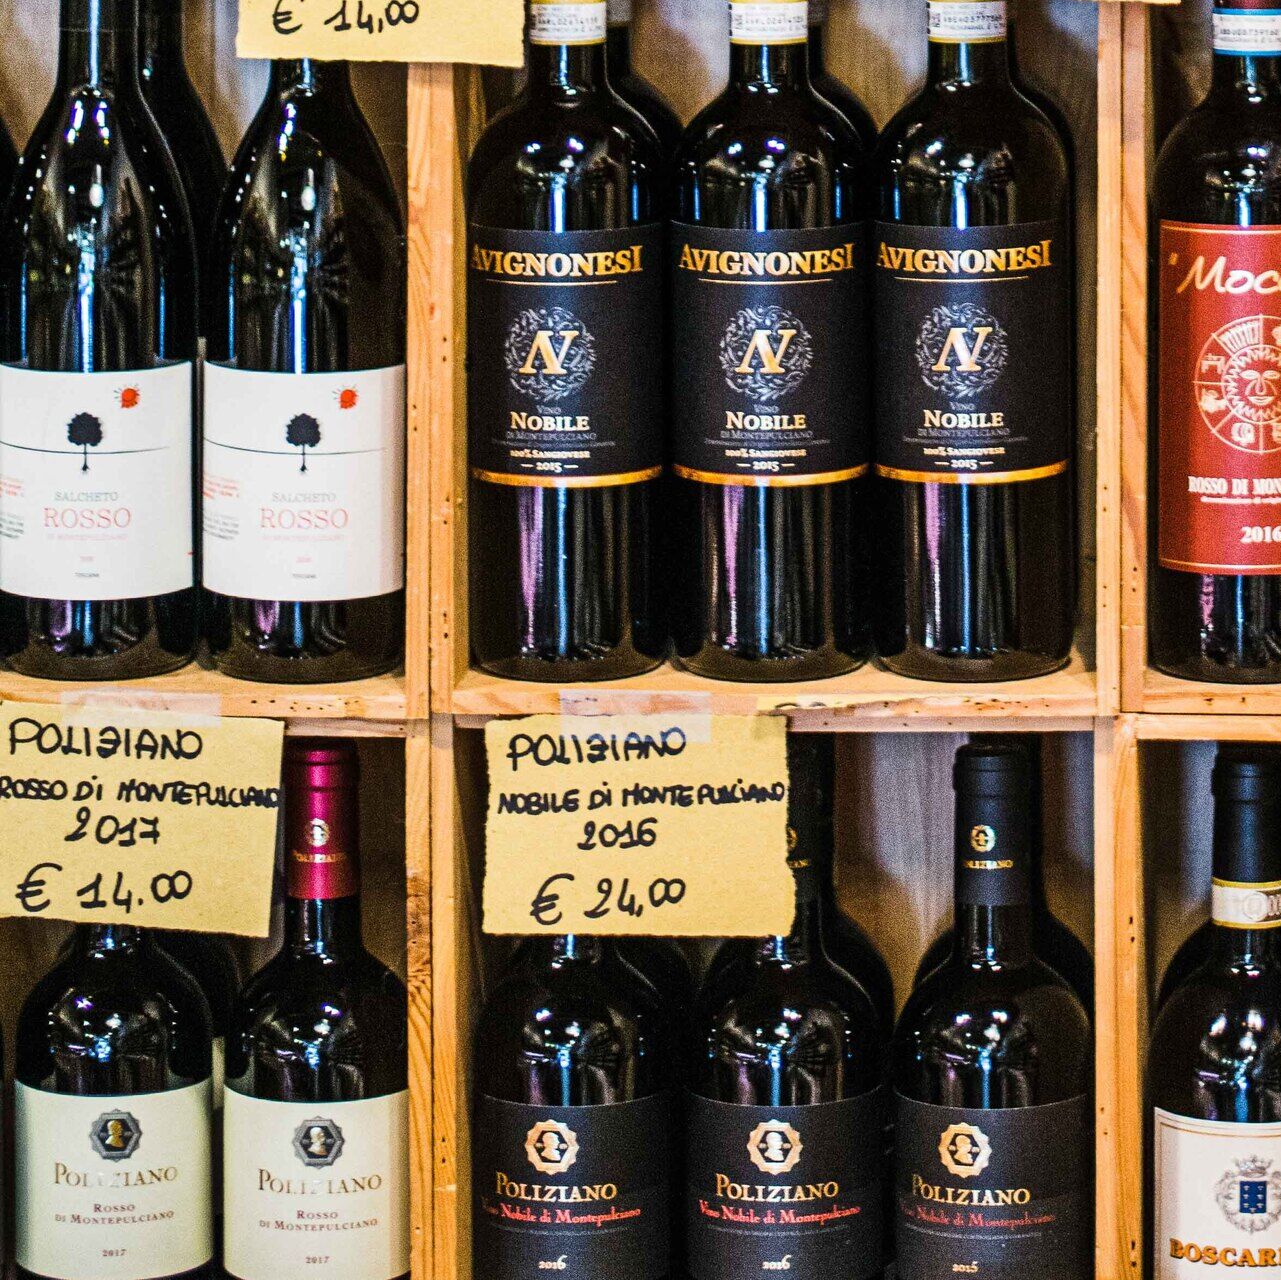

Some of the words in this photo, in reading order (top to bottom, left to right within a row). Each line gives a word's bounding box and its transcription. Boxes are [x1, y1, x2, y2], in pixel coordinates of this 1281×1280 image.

[324, 0, 420, 34] 14,00
[678, 242, 854, 276] AVIGNONESI
[725, 410, 806, 430] NOBILE
[752, 459, 780, 473] 2015
[53, 490, 119, 502] SALCHETO
[1188, 476, 1227, 494] ROSSO
[1230, 476, 1248, 492] DI
[43, 507, 133, 531] ROSSO
[64, 806, 161, 847] 2017
[577, 816, 659, 851] 2016
[15, 862, 63, 913] €
[529, 872, 575, 926] €
[496, 1172, 617, 1202] POLIZIANO
[93, 1203, 136, 1214] ROSSO
[101, 1248, 127, 1258] 2017
[539, 1255, 568, 1270] 2016
